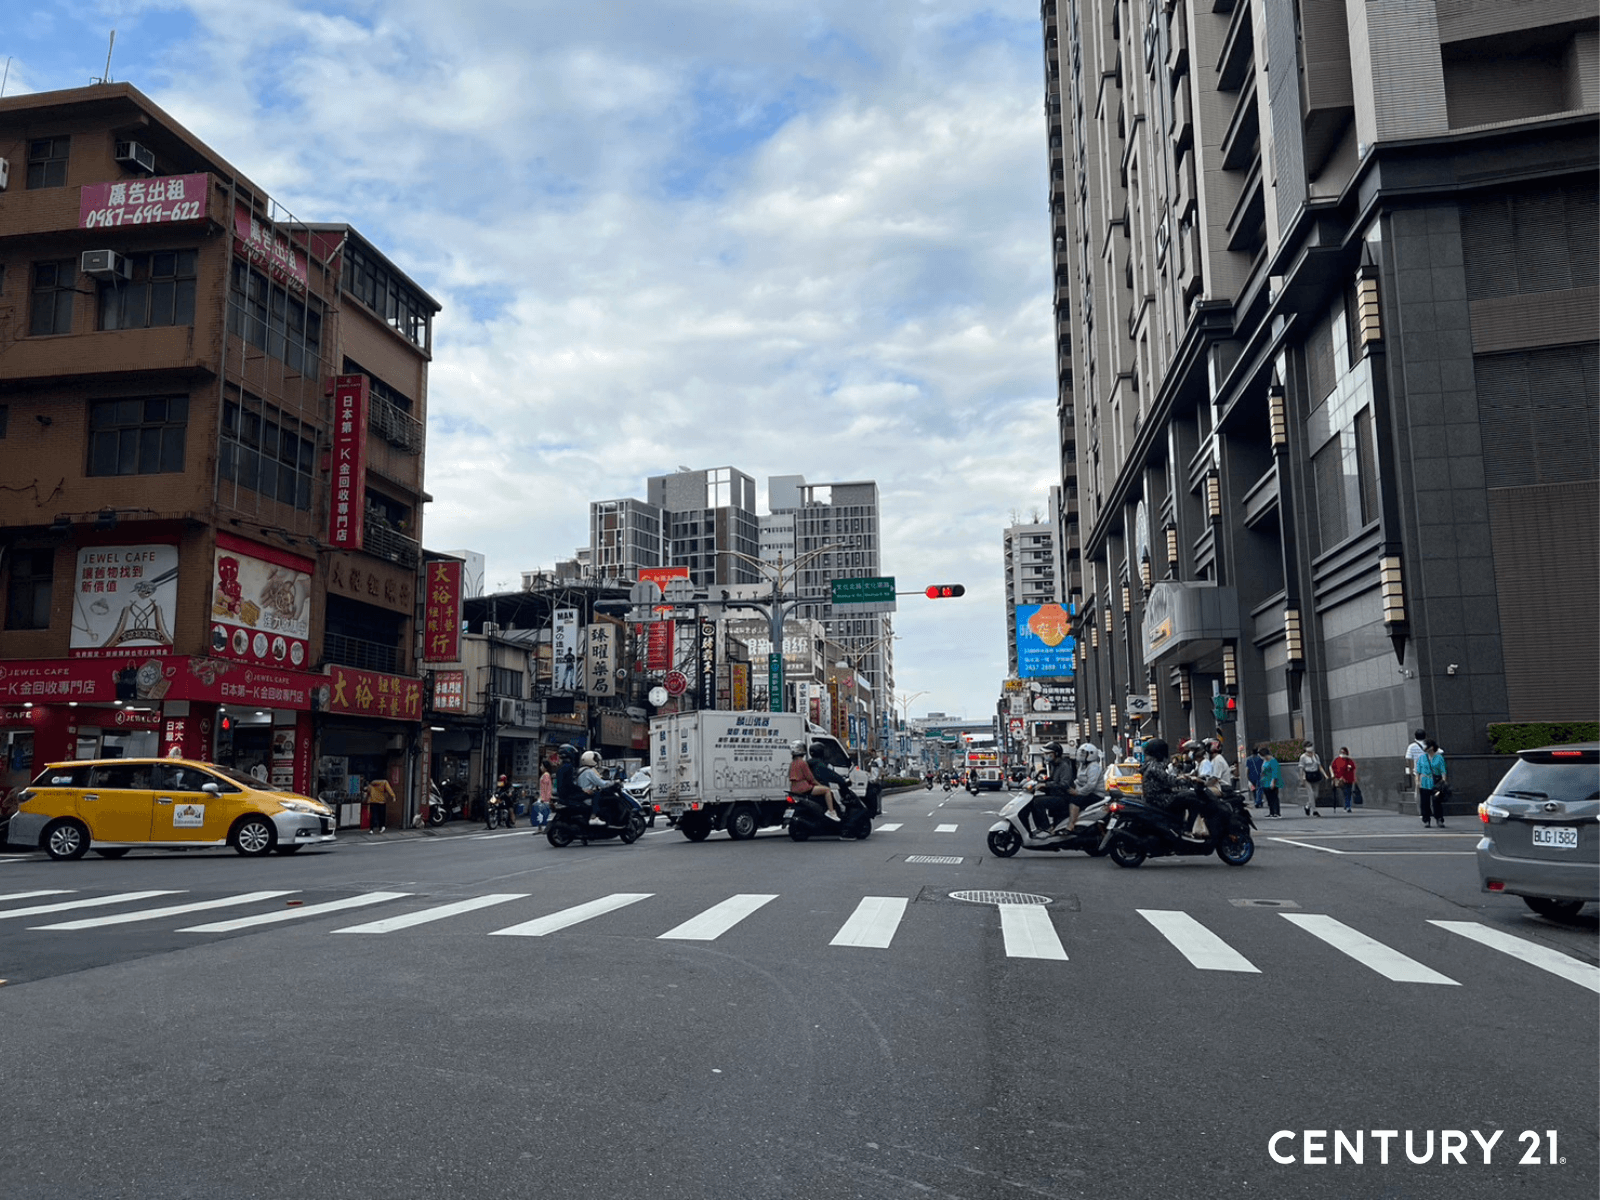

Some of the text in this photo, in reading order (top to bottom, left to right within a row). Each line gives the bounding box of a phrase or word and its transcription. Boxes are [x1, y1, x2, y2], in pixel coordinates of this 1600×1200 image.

[108, 179, 185, 207] 廣告出租
[86, 201, 200, 228] 0987-699-622
[336, 396, 353, 541] 日本第一K金回收專門店
[83, 552, 156, 564] JEWEL CAFE
[81, 581, 118, 593] 新價值
[557, 611, 573, 620] MAN
[8, 668, 70, 676] JEWEL CAFE
[253, 675, 290, 684] JEWEL CAFE
[220, 682, 304, 703] 日本第一K金回收專門店
[5, 711, 32, 719] CAFE
[152, 715, 161, 723] CA
[166, 720, 185, 731] 日本
[165, 731, 184, 742] 最大
